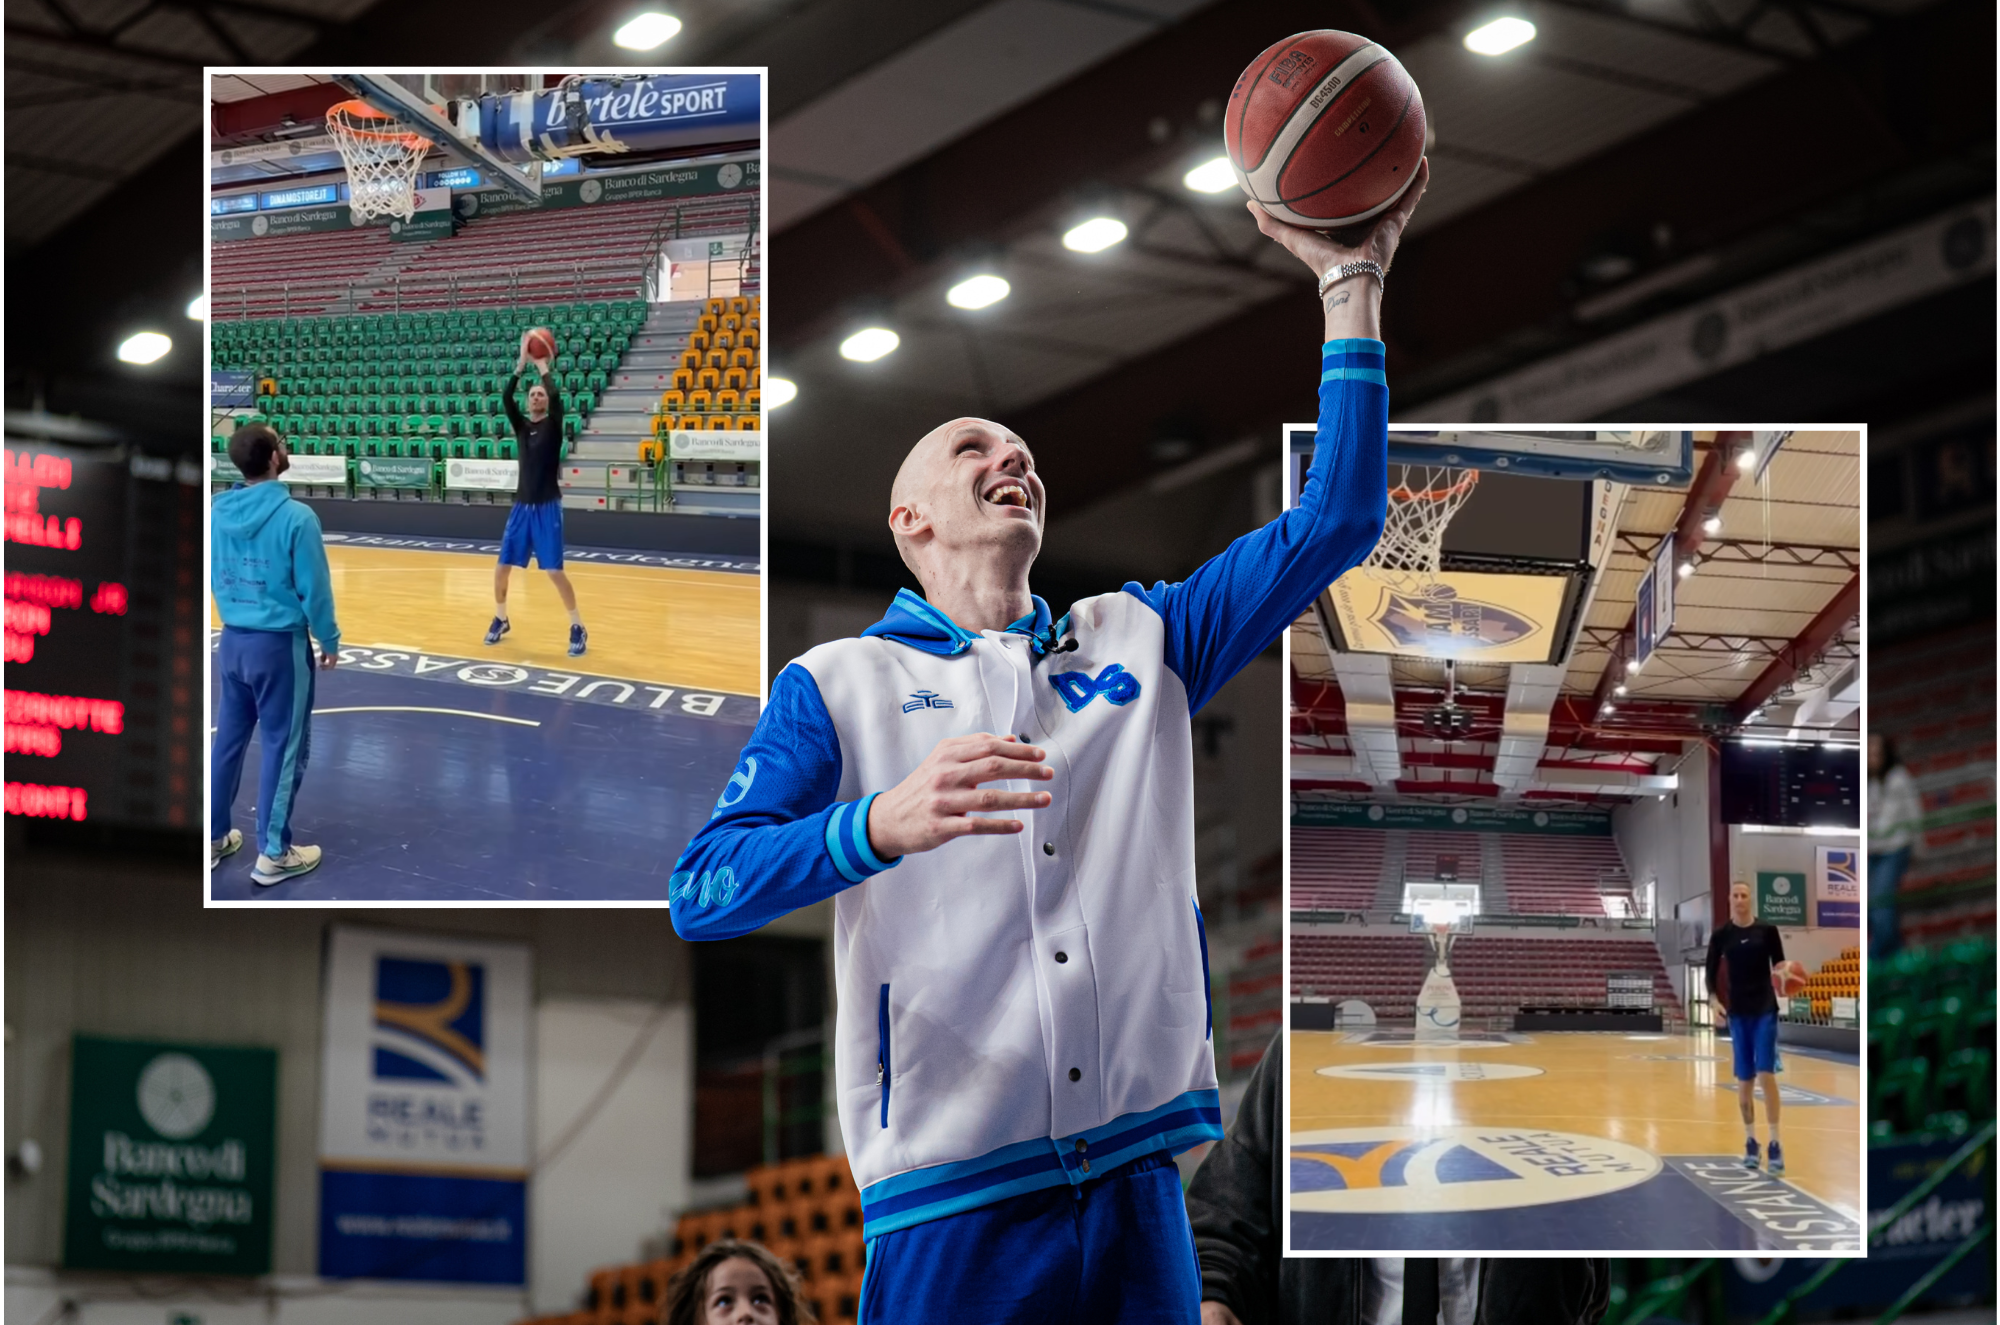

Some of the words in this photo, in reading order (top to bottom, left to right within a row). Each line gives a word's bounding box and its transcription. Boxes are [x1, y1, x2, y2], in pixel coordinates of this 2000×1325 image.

[1268, 50, 1307, 85] FIBA
[660, 87, 727, 115] SPORT
[1309, 76, 1341, 109] BG4500
[604, 176, 637, 190] Banco
[638, 174, 647, 186] di
[648, 171, 698, 184] Sardegna
[480, 192, 509, 204] Banco
[269, 213, 293, 226] Banco
[293, 212, 300, 222] di
[300, 209, 337, 223] Sardegna
[528, 672, 726, 717] BLUE
[1765, 894, 1790, 904] Banco
[1828, 884, 1857, 892] REALE
[1763, 904, 1802, 916] Sardegna
[366, 1094, 485, 1131] REALE
[103, 1130, 213, 1180] Banco
[1477, 1134, 1604, 1177] REALE
[91, 1172, 253, 1231] Sardegna
